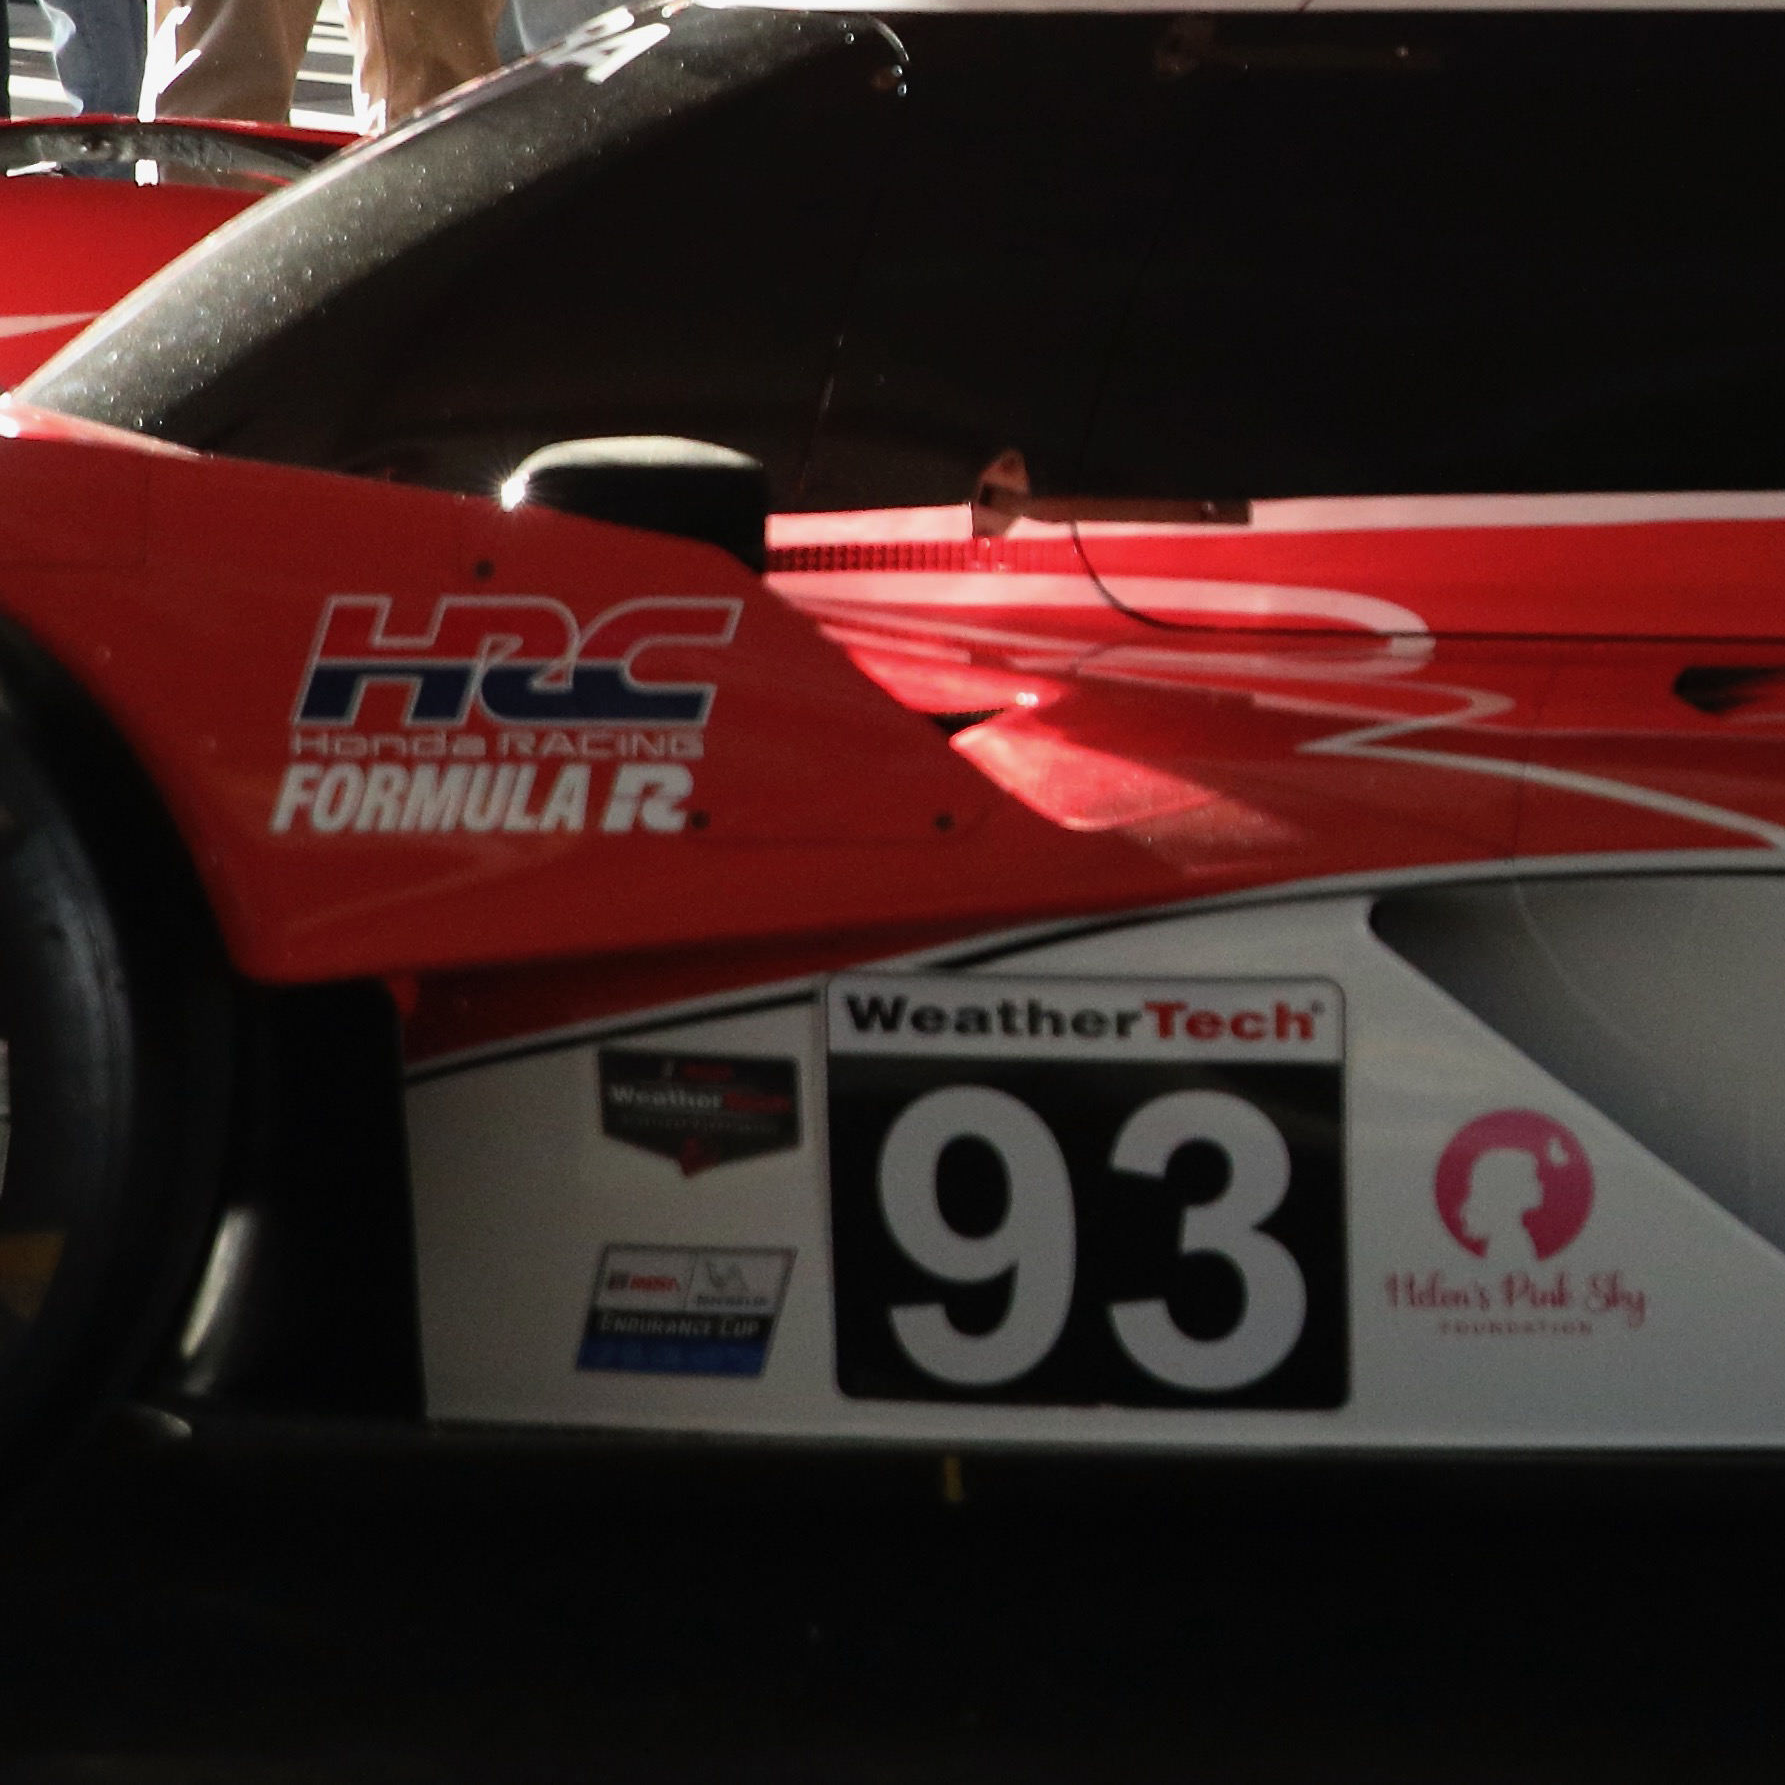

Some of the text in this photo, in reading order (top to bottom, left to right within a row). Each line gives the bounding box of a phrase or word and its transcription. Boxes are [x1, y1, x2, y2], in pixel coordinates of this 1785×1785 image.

[292, 594, 744, 727] HRC
[290, 732, 705, 759] Honda RACING
[269, 762, 695, 835] FORMULA R
[843, 991, 1318, 1043] WeatherTech
[876, 1083, 1309, 1393] 93
[599, 1313, 761, 1338] ENDURANCE CUP
